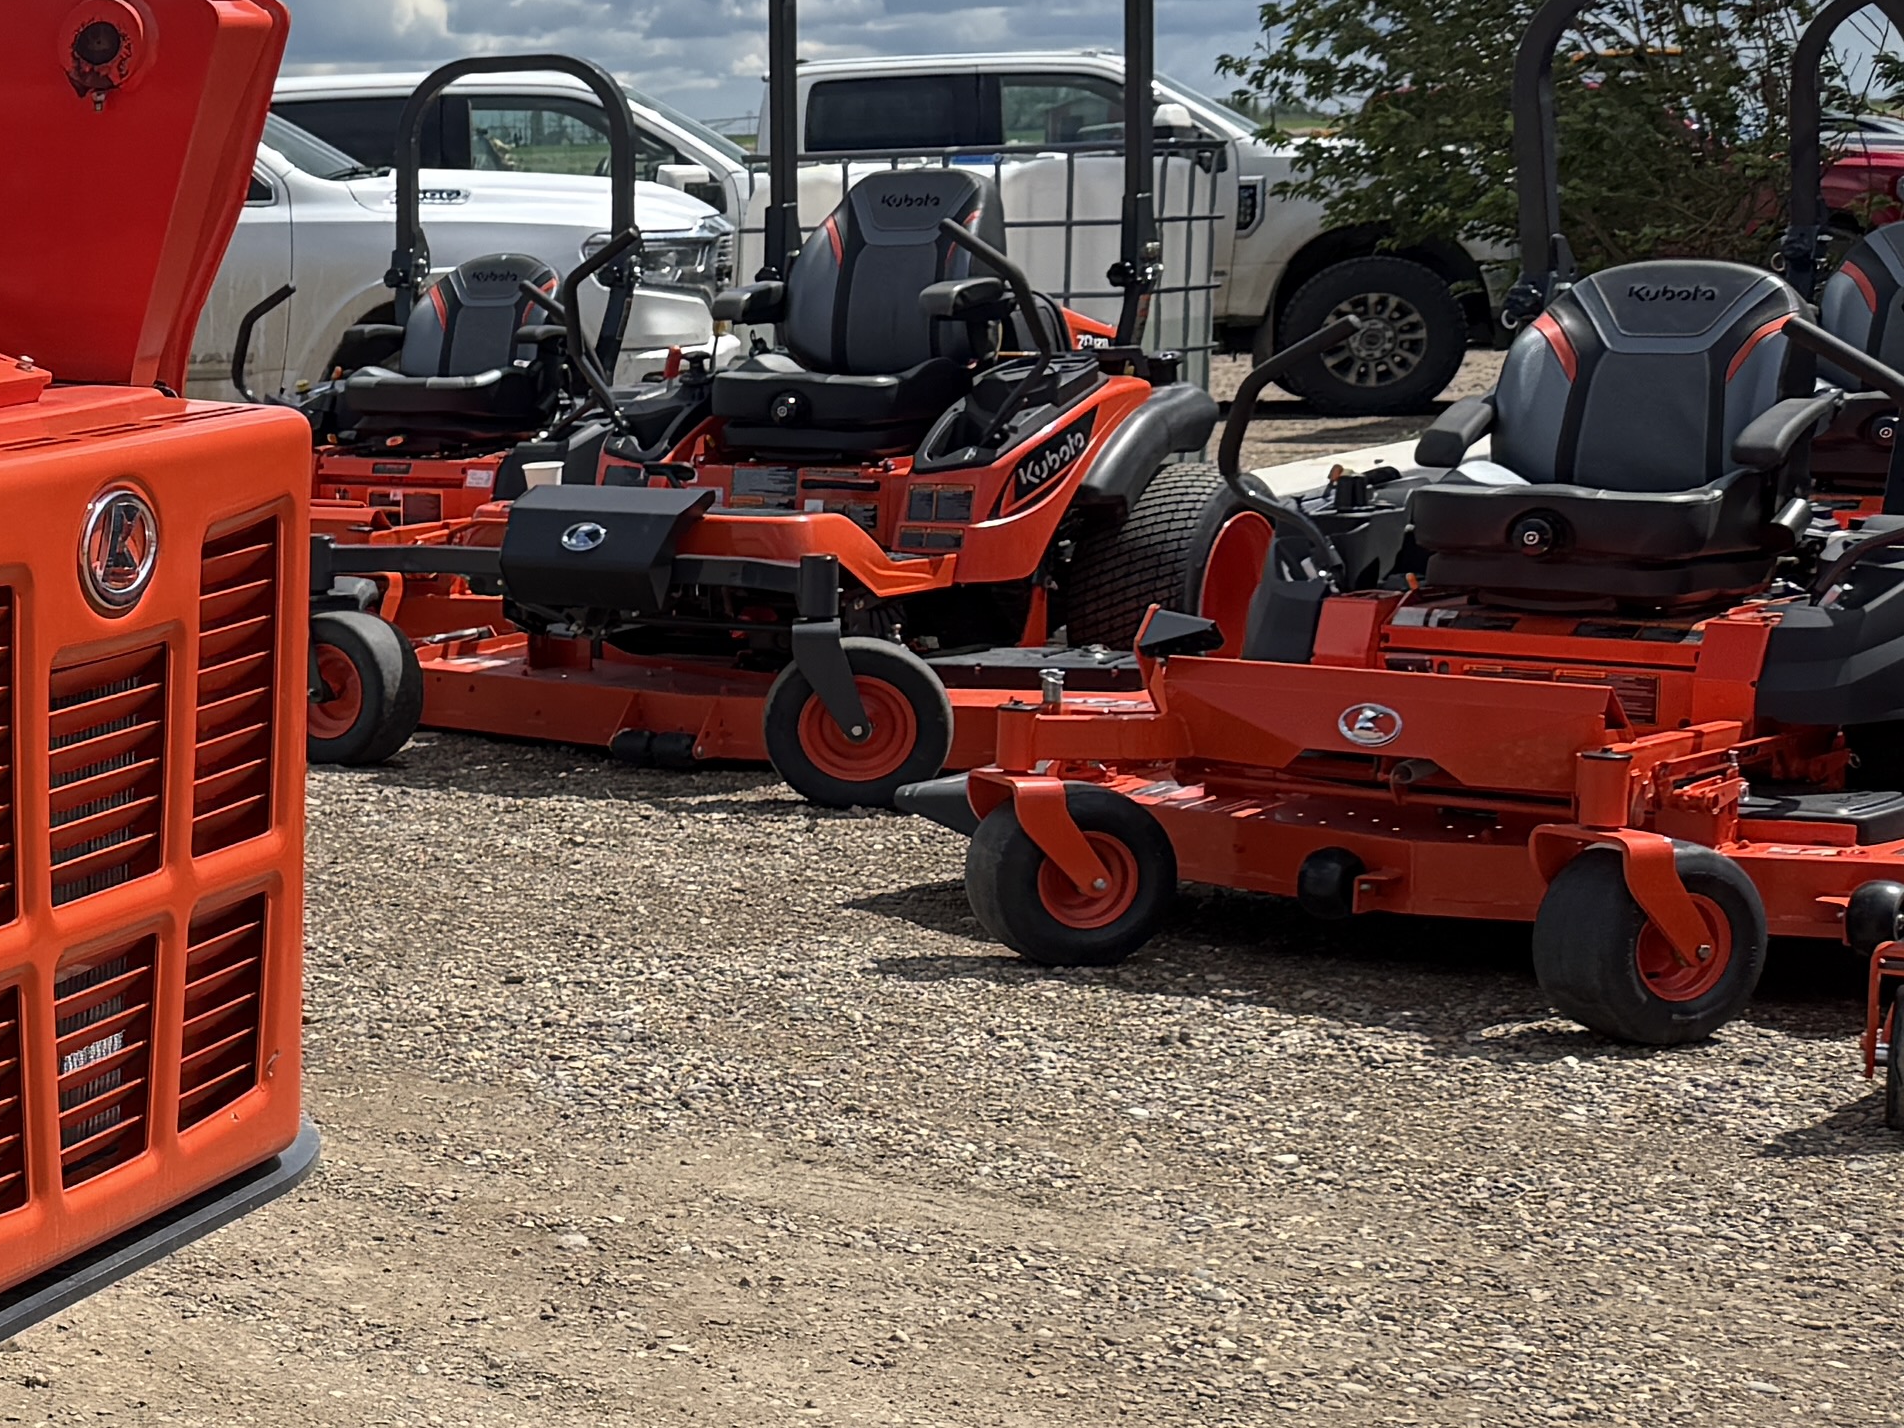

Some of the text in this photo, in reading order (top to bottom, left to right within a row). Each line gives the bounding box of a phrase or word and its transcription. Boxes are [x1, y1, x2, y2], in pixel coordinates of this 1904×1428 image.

[881, 193, 941, 208] Kubota
[1627, 284, 1717, 302] Kubota
[1018, 431, 1086, 486] Kubota
